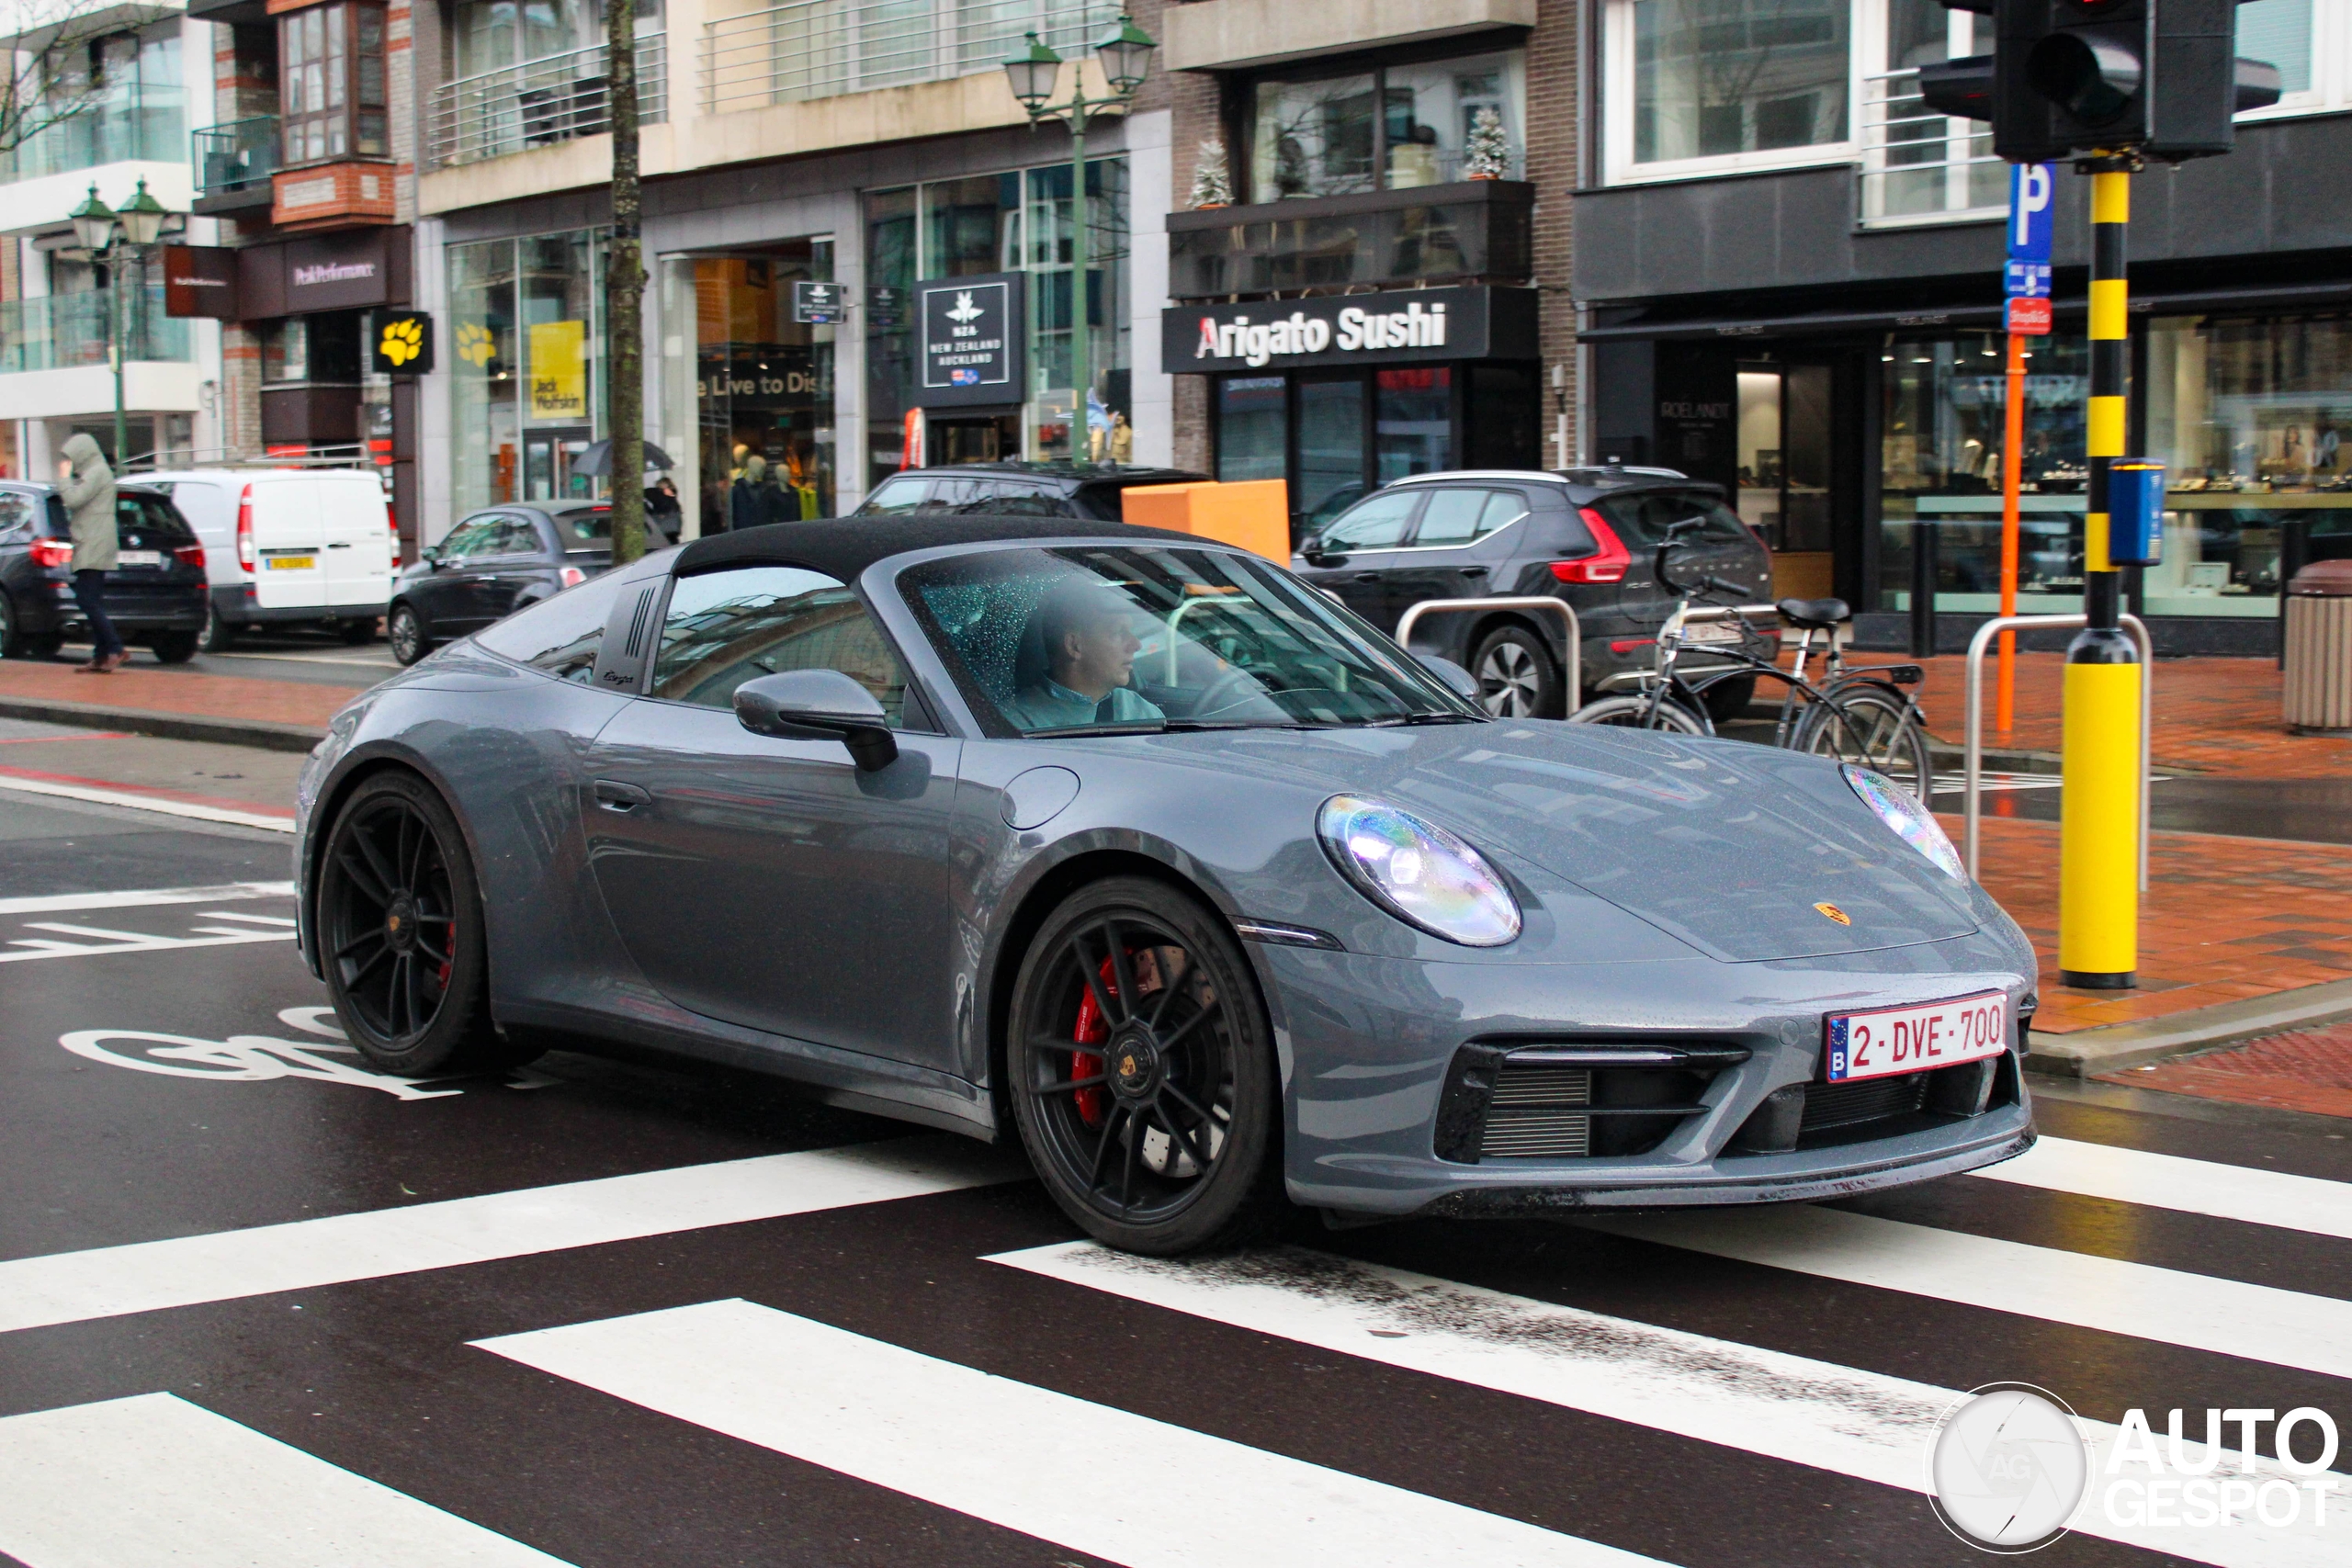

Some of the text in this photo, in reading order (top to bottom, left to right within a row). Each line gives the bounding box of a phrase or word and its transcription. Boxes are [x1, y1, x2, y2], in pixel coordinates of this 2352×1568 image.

[2016, 164, 2051, 245] P
[1195, 302, 1446, 367] Arigato Sushi
[929, 338, 1002, 354] NEW ZEALAND
[938, 353, 993, 366] AUCKLAND
[535, 377, 556, 393] Jack
[711, 375, 755, 397] Live
[760, 376, 784, 395] to
[1074, 1006, 1088, 1067] POSCHE
[1832, 1052, 1845, 1072] B
